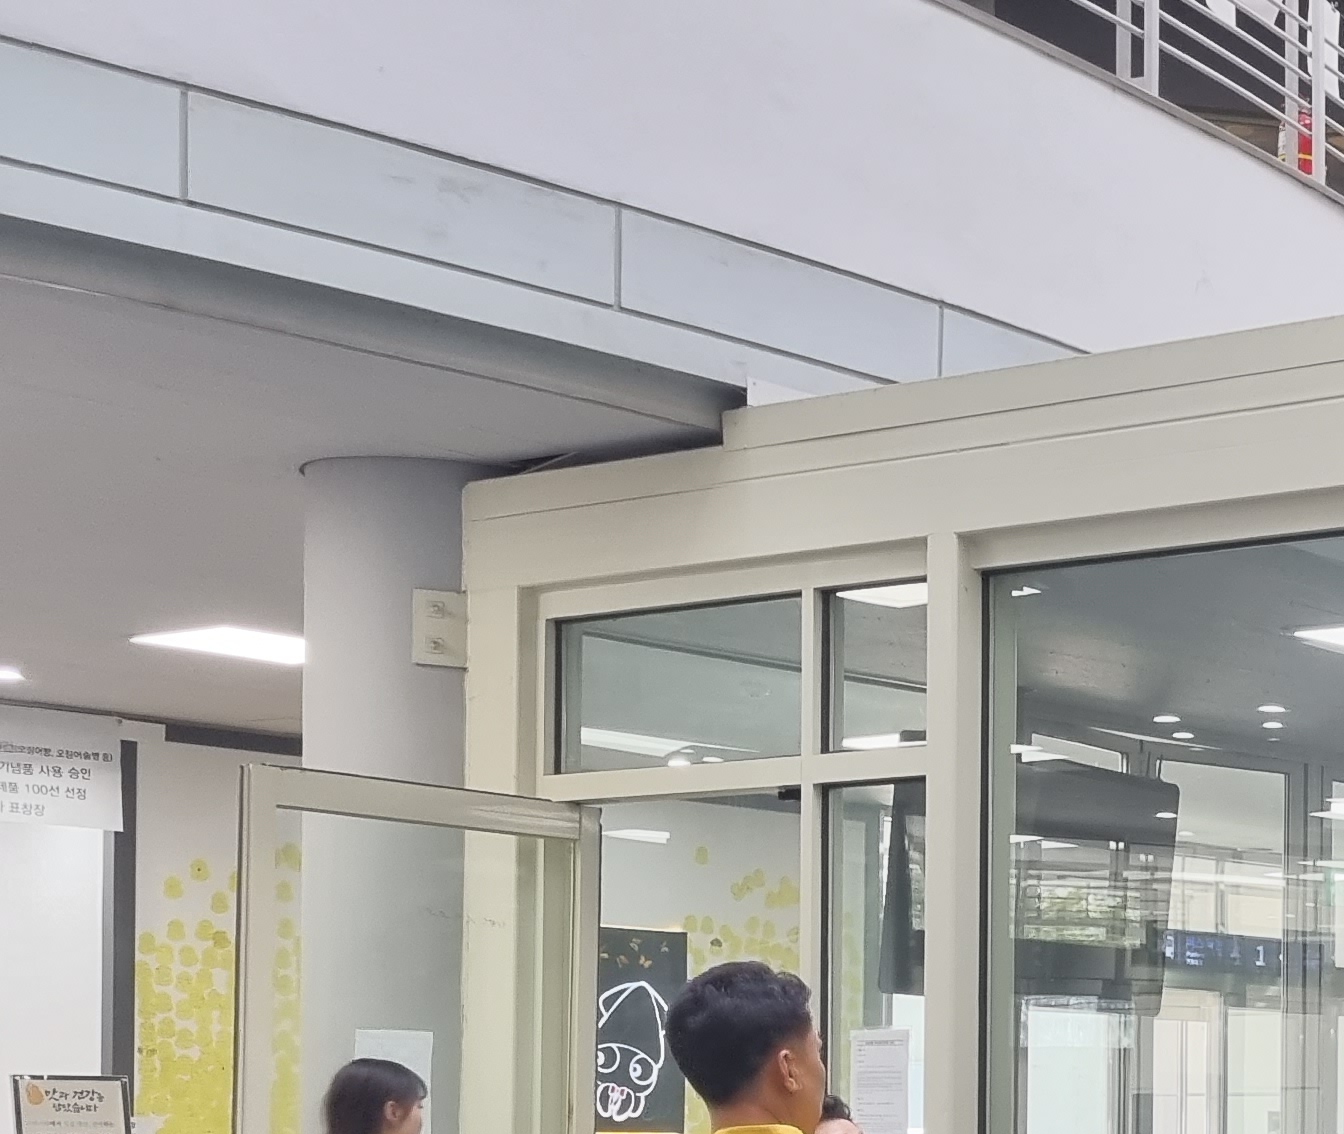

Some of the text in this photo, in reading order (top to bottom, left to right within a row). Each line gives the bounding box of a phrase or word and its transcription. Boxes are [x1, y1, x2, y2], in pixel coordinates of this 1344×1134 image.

[39, 764, 63, 778] 사용
[68, 766, 91, 781] 승인
[25, 783, 60, 797] 100선
[64, 786, 87, 801] 선정
[9, 801, 45, 817] 표창장
